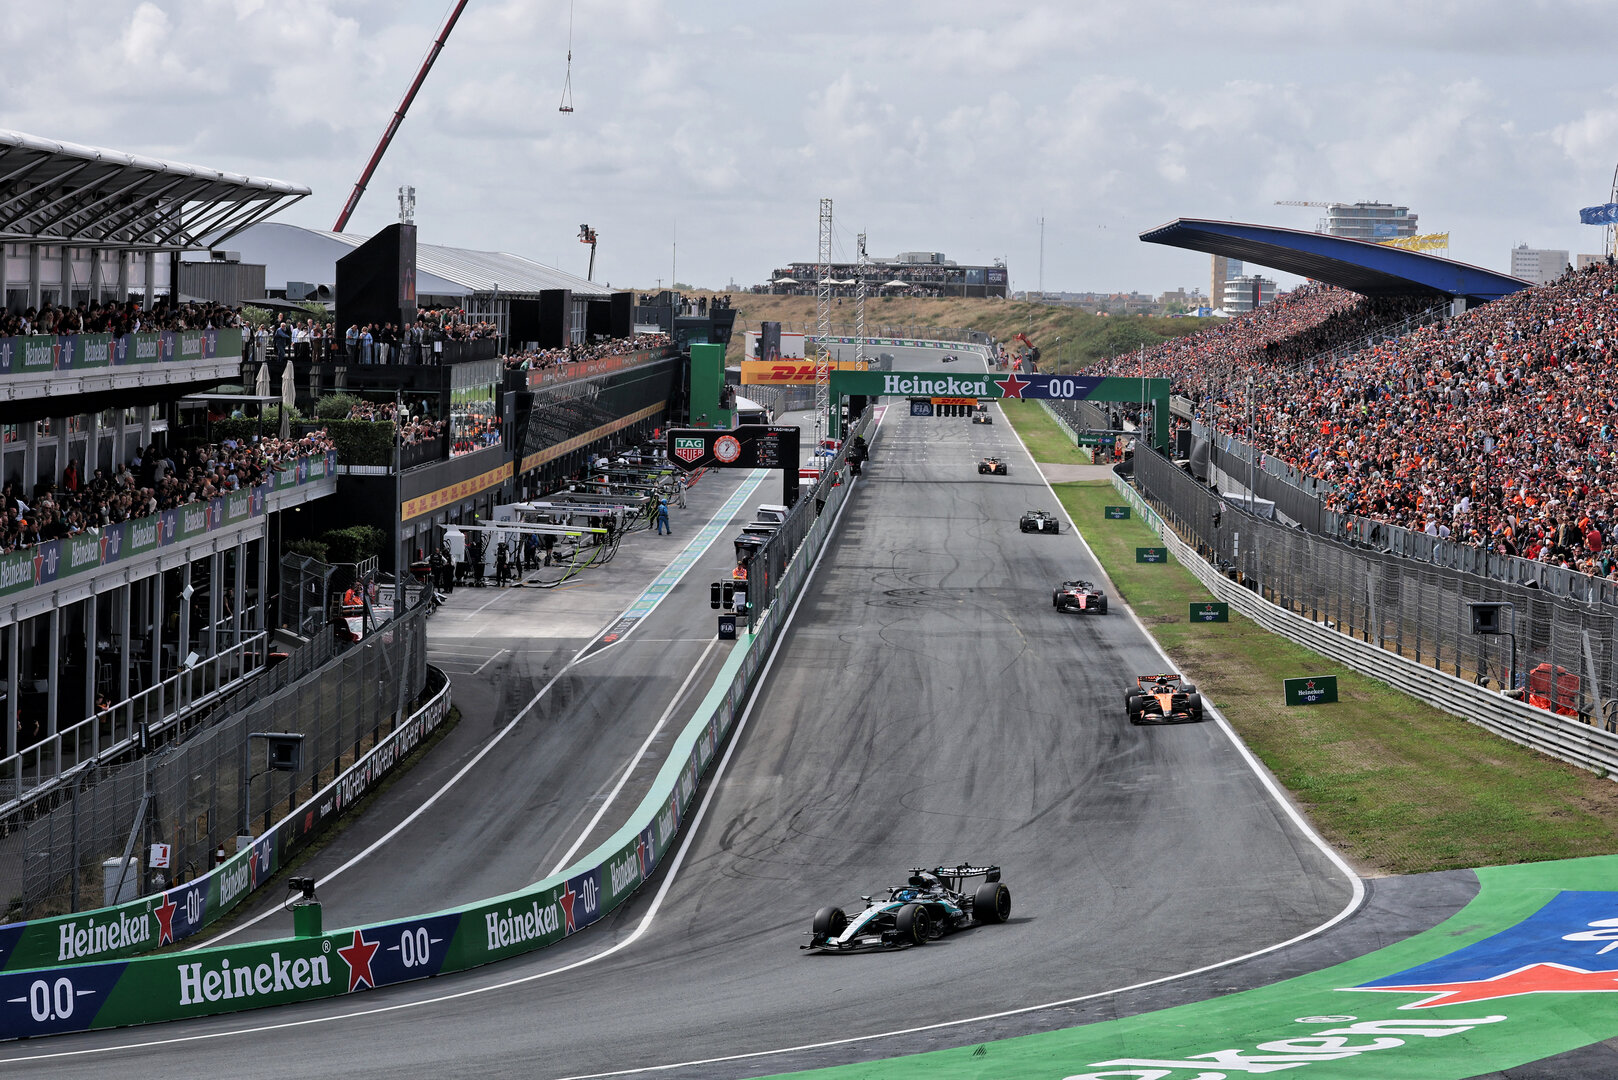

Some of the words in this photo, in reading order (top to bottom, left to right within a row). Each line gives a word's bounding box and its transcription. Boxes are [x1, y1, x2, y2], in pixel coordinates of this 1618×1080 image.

[25, 341, 51, 366] Heineken
[883, 375, 988, 396] Heineken
[1049, 379, 1075, 398] 0.0
[914, 404, 930, 413] FIA
[676, 449, 703, 461] HEUER
[677, 440, 702, 448] TAG
[0, 557, 32, 589] Heineken
[71, 538, 98, 568] Heineken
[131, 522, 156, 549] Heineken
[720, 624, 734, 632] FIA
[57, 911, 151, 961] Heineken
[220, 861, 249, 907] Heineken
[30, 977, 74, 1022] 0.0
[178, 952, 332, 1006] Heineken
[400, 927, 430, 968] 0.0
[486, 901, 560, 950] Heineken
[610, 851, 638, 897] Heineken
